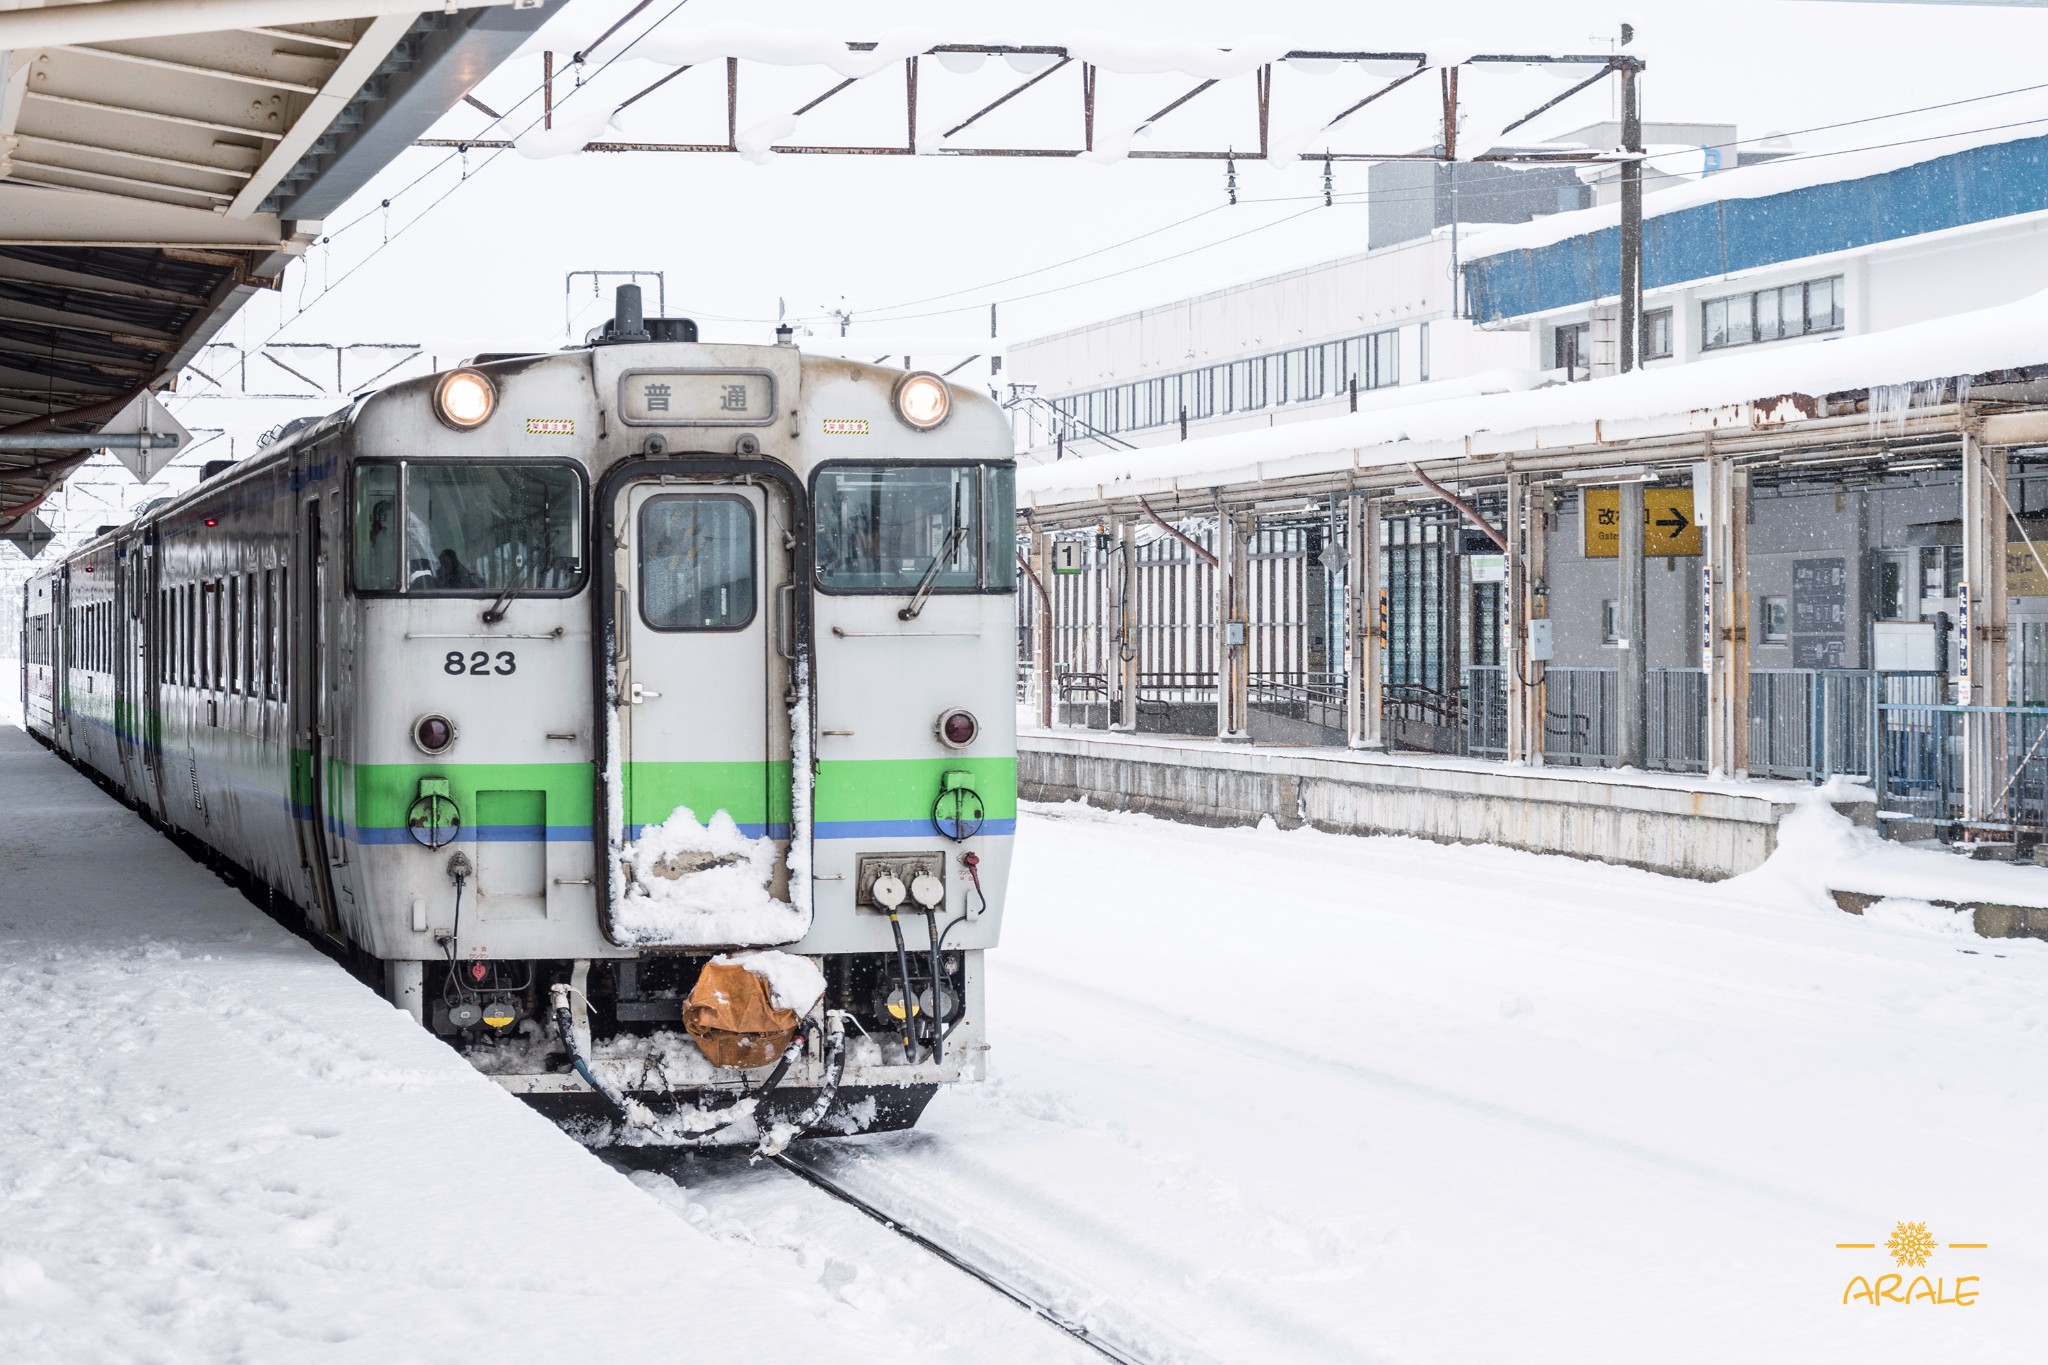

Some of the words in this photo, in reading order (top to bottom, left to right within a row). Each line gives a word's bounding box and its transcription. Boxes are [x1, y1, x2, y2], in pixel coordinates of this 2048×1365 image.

[1598, 531, 1619, 540] Gate
[1062, 545, 1071, 567] 1
[1959, 592, 1968, 671] たきかわ
[444, 650, 517, 676] 823
